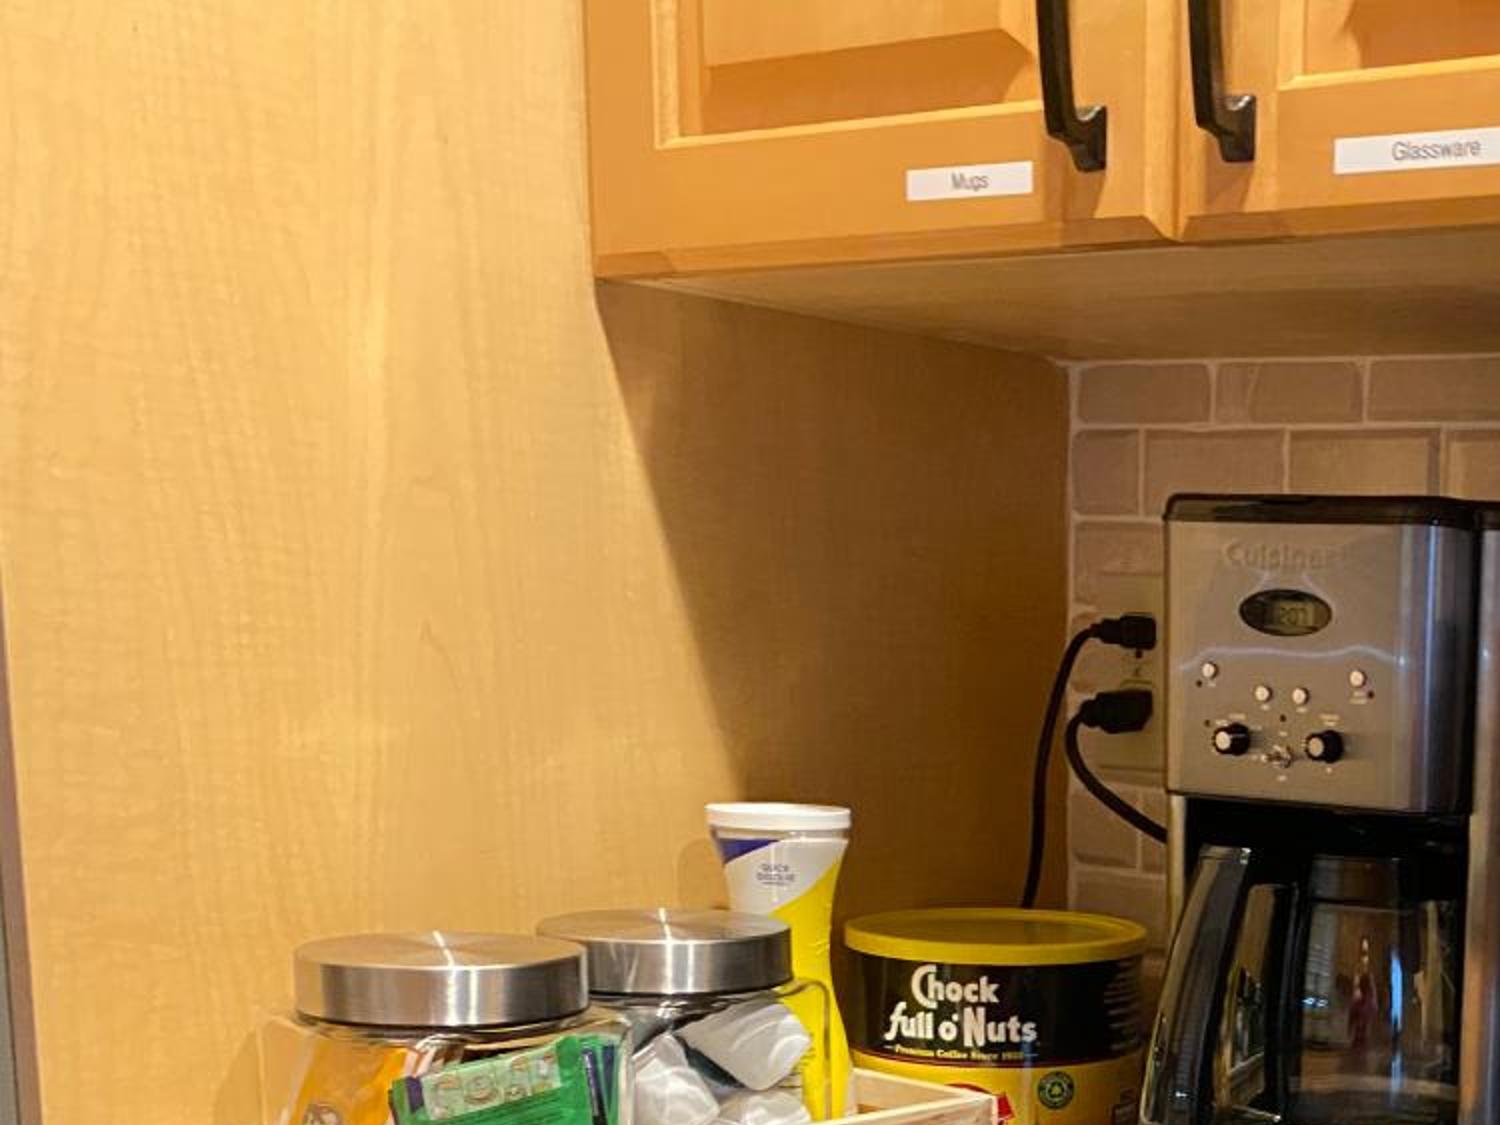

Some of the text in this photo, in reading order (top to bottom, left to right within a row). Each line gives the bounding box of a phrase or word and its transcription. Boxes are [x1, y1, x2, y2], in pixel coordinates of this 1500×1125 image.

[1391, 138, 1482, 161] Glassware
[951, 171, 990, 192] Mugs
[911, 963, 1000, 1010] Chock
[884, 1001, 934, 1041] full
[963, 1006, 1038, 1048] Nuts
